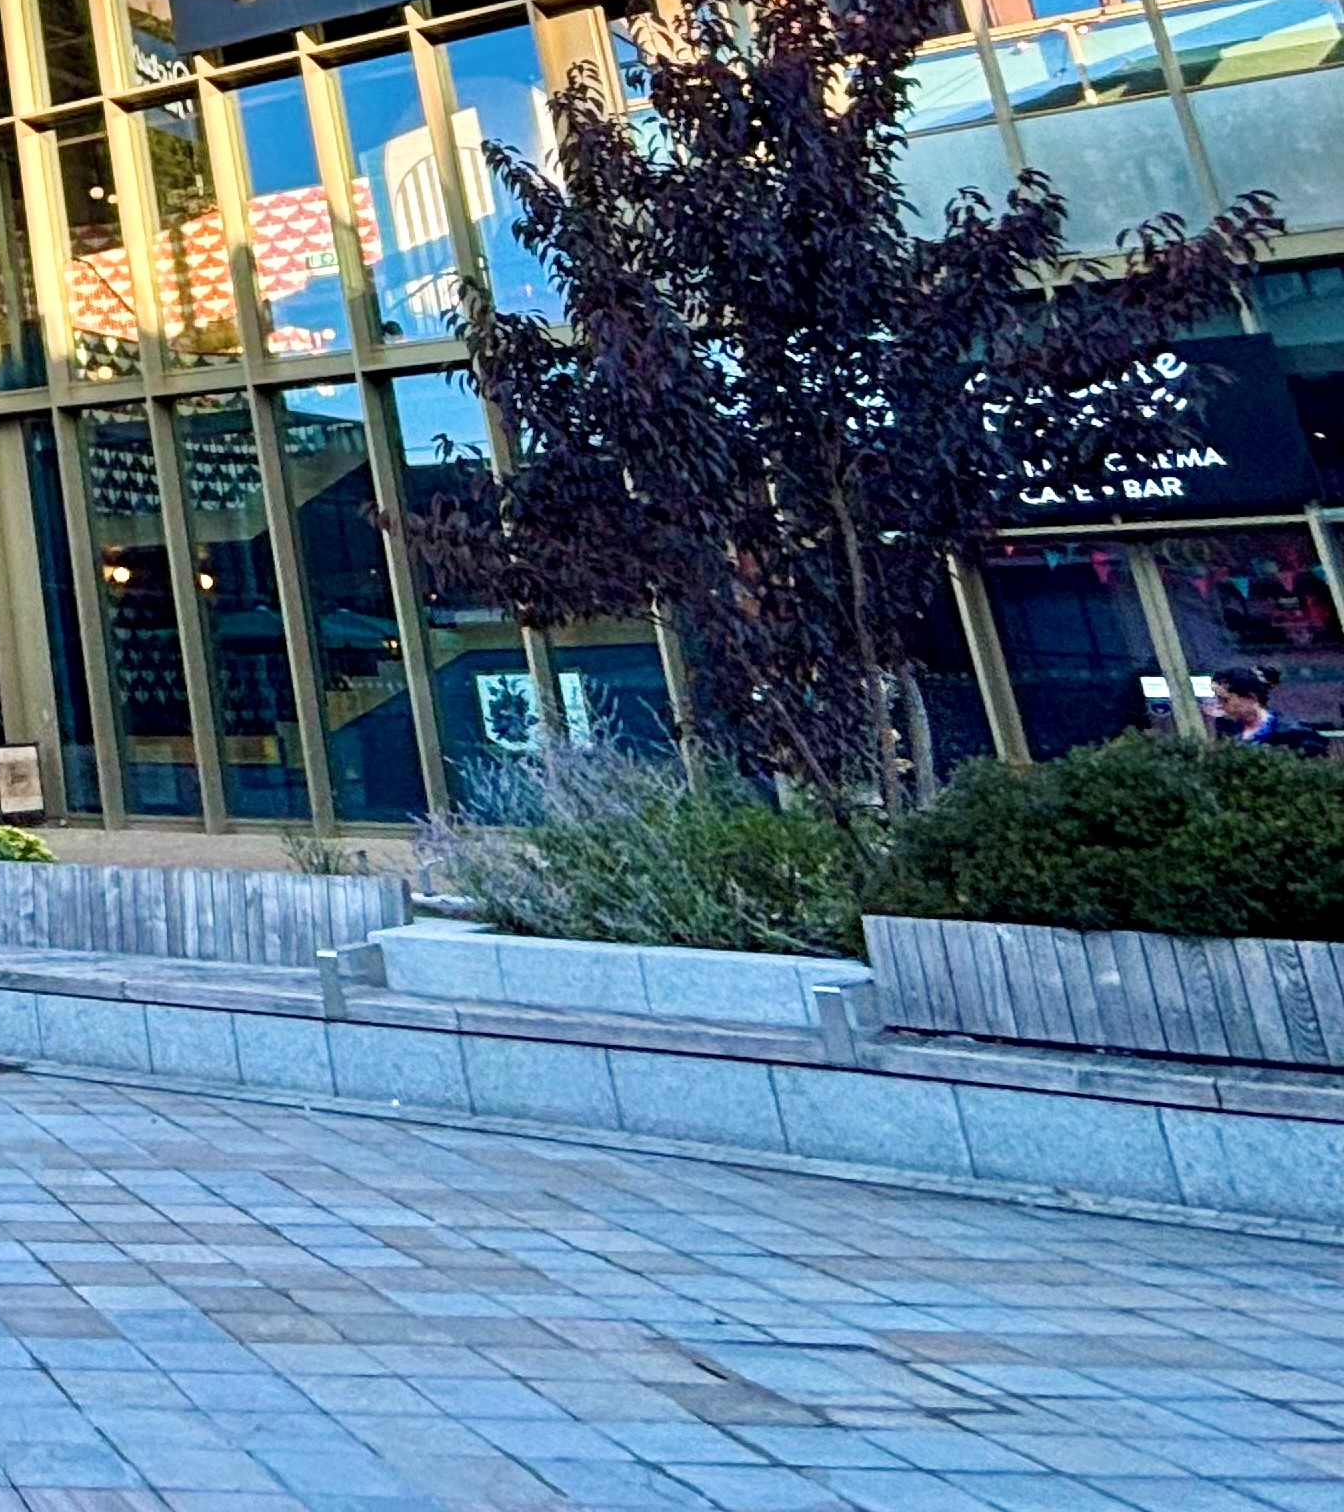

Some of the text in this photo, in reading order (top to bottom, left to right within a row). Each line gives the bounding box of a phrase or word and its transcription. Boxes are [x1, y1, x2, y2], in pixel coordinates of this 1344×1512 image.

[1104, 446, 1227, 471] CEMA
[1019, 476, 1185, 504] CAE BAR
